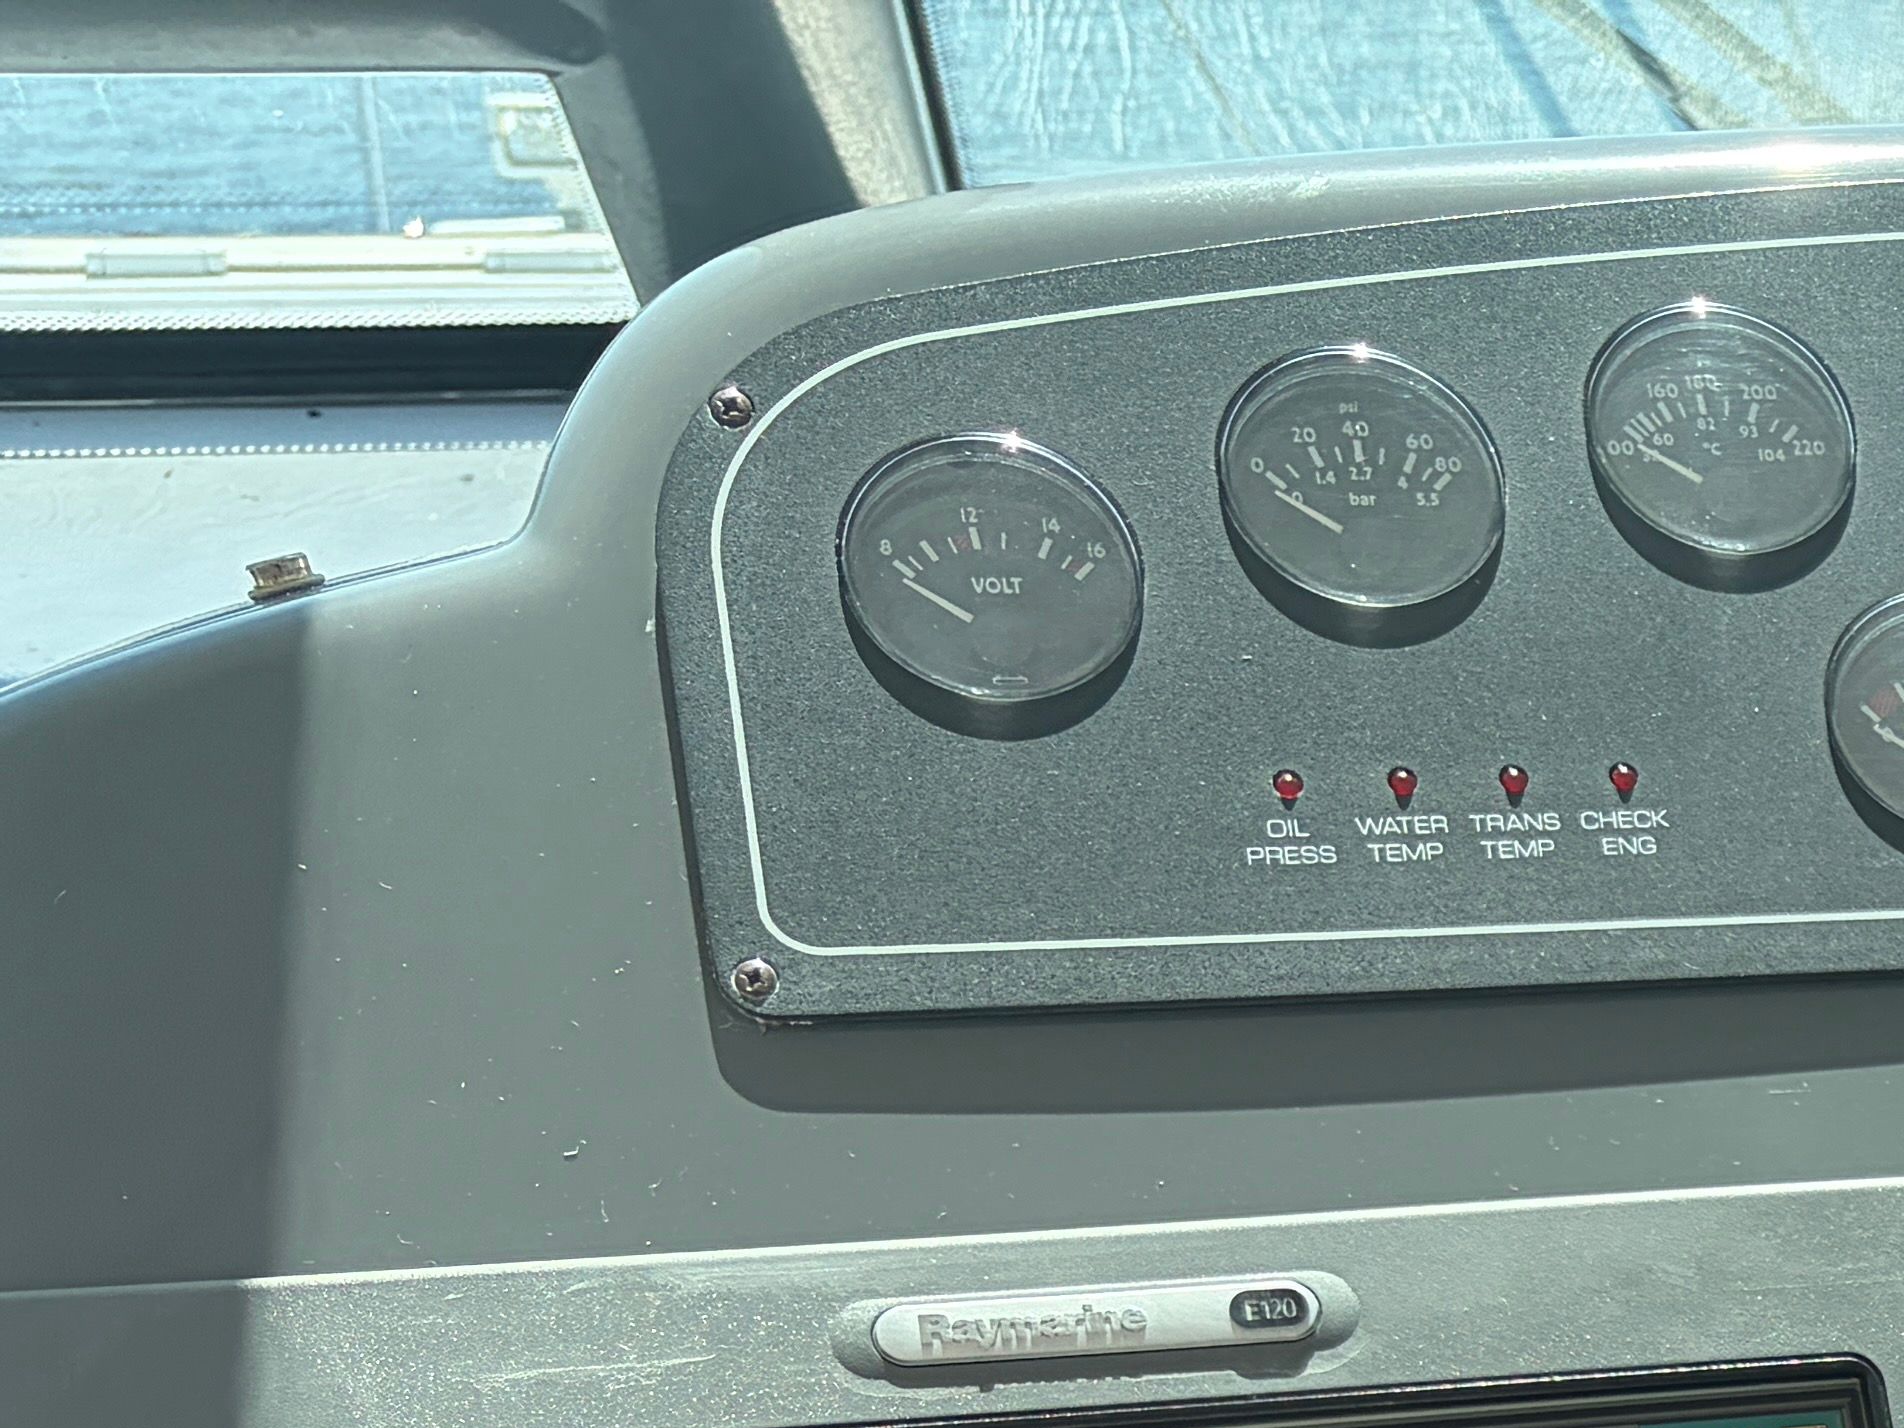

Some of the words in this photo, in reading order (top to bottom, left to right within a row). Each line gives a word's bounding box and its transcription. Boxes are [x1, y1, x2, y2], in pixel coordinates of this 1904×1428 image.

[1647, 382, 1678, 398] 160
[1742, 383, 1776, 399] 200
[1291, 428, 1316, 443] 20
[1342, 421, 1369, 438] 40
[1406, 433, 1432, 450] 60
[1435, 456, 1461, 472] 80
[1349, 491, 1375, 508] bar
[1041, 517, 1060, 534] 14
[1086, 542, 1106, 558] 16
[971, 576, 1022, 595] VOLT
[1267, 819, 1310, 838] OIL
[1355, 814, 1449, 836] WATER
[1469, 812, 1561, 833] TRANS
[1580, 810, 1669, 830] CHECK
[1246, 844, 1337, 866] PRESS
[1367, 841, 1443, 862] TEMP
[1481, 838, 1555, 859] TEMP
[1603, 837, 1657, 855] ENG
[1243, 1299, 1296, 1322] E120
[918, 1304, 1148, 1355] Raymarine
